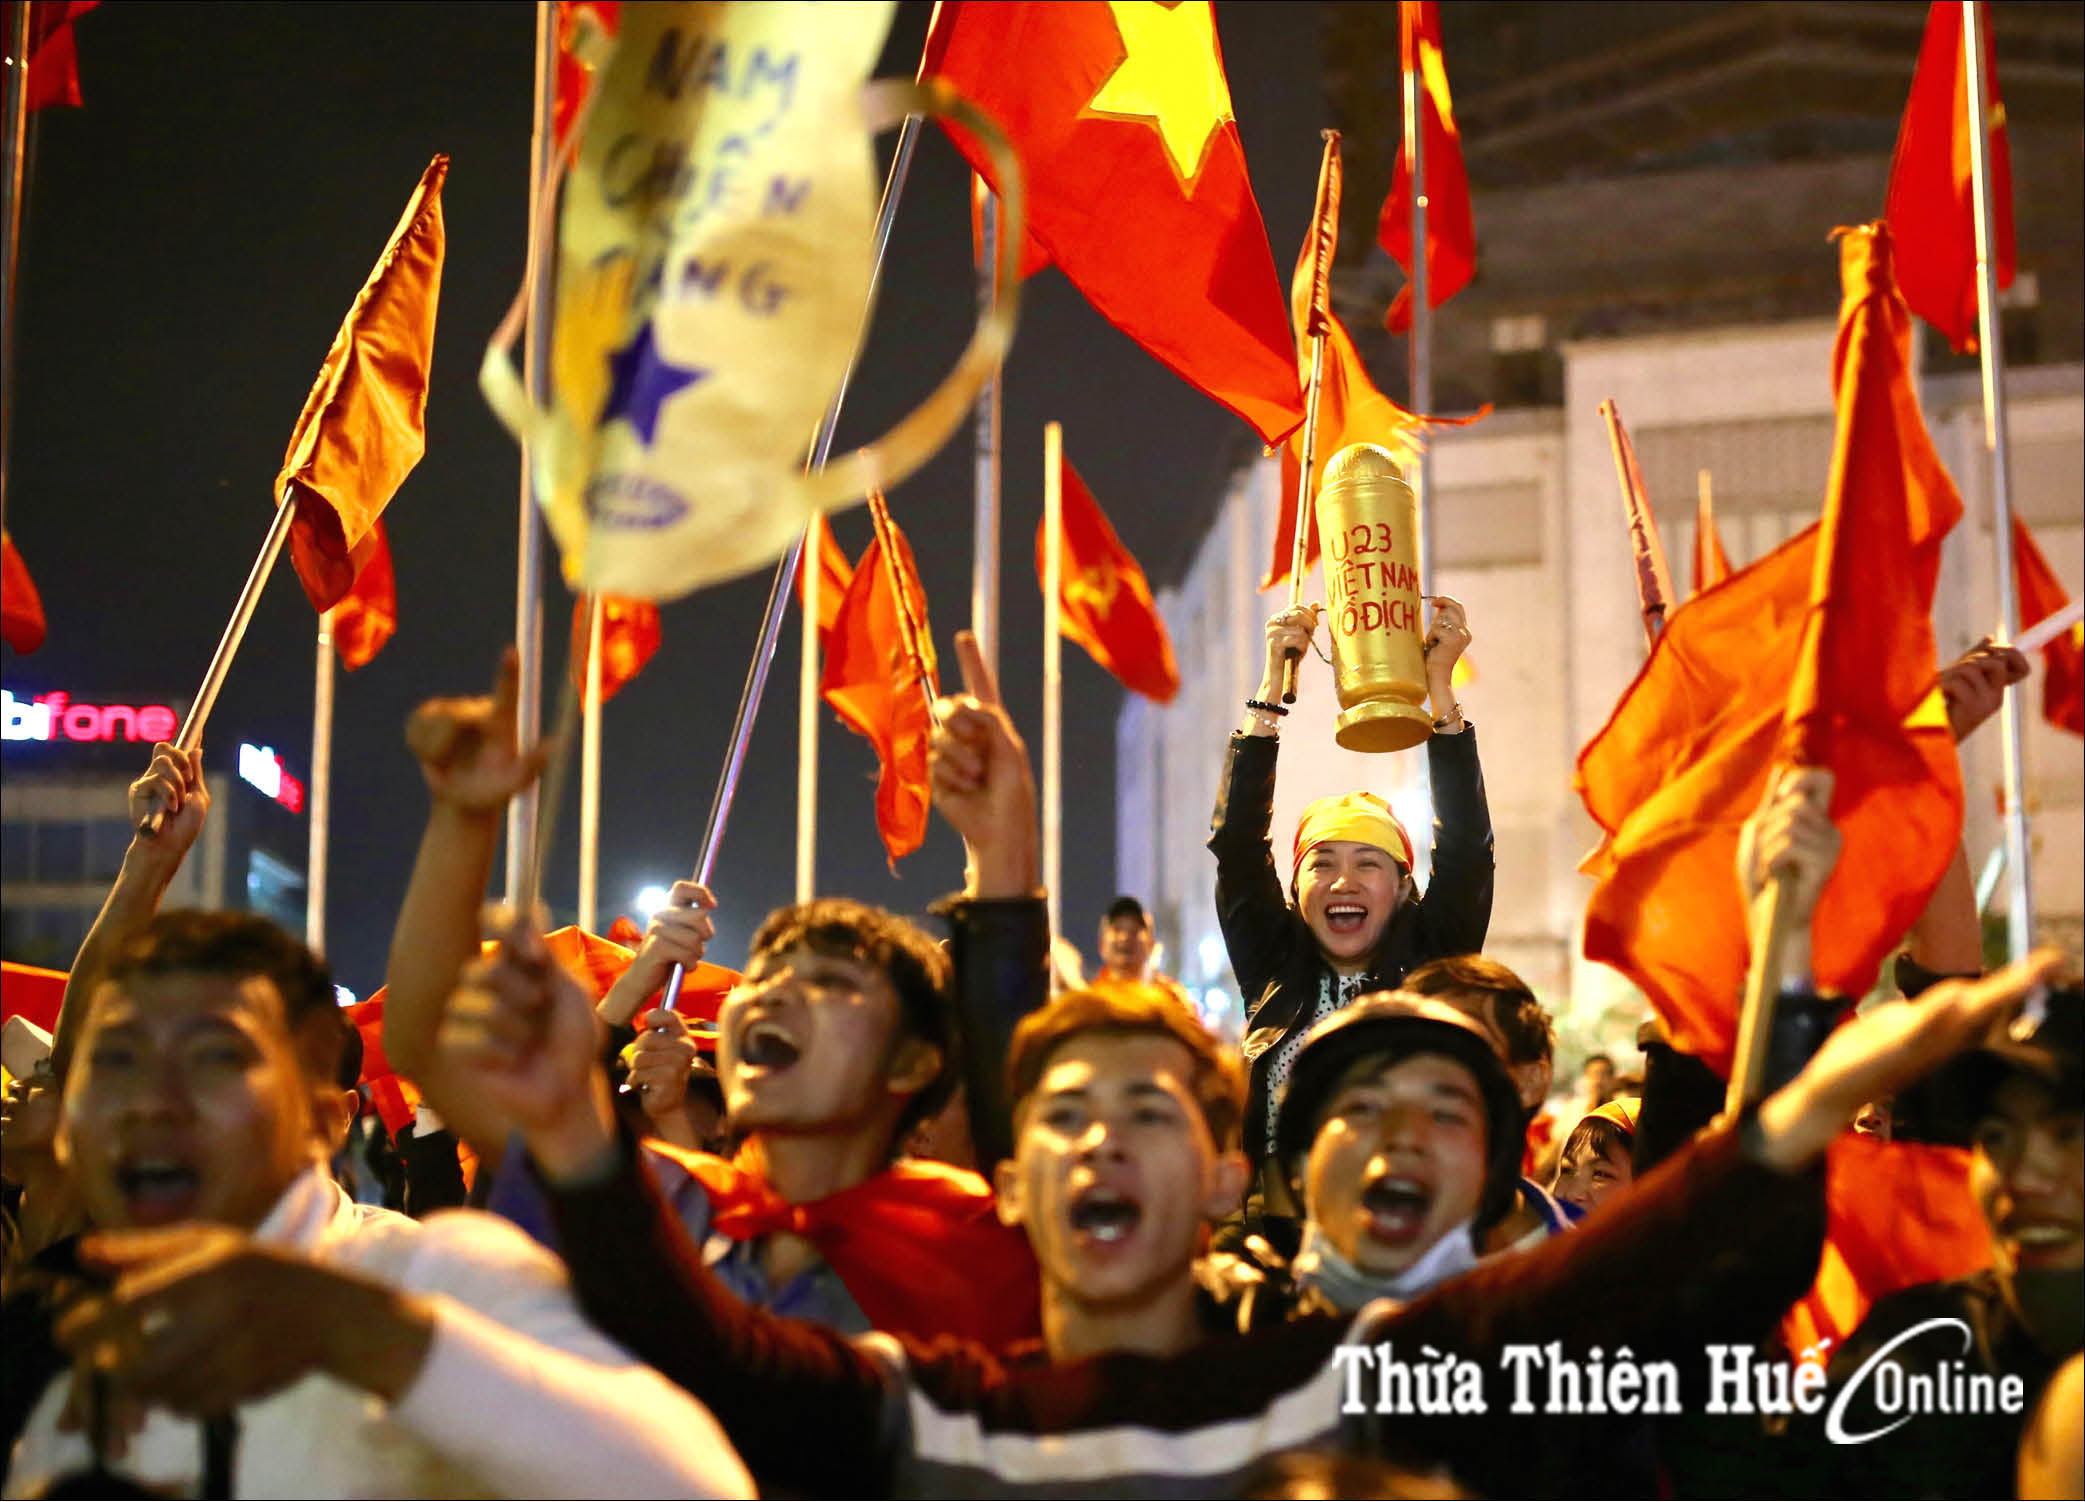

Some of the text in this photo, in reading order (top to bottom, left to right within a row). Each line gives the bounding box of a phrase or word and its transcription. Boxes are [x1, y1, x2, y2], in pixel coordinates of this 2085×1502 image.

[1330, 523, 1392, 561] U23
[1380, 561, 1421, 597] NAM
[1359, 591, 1417, 637] ĐỊCH
